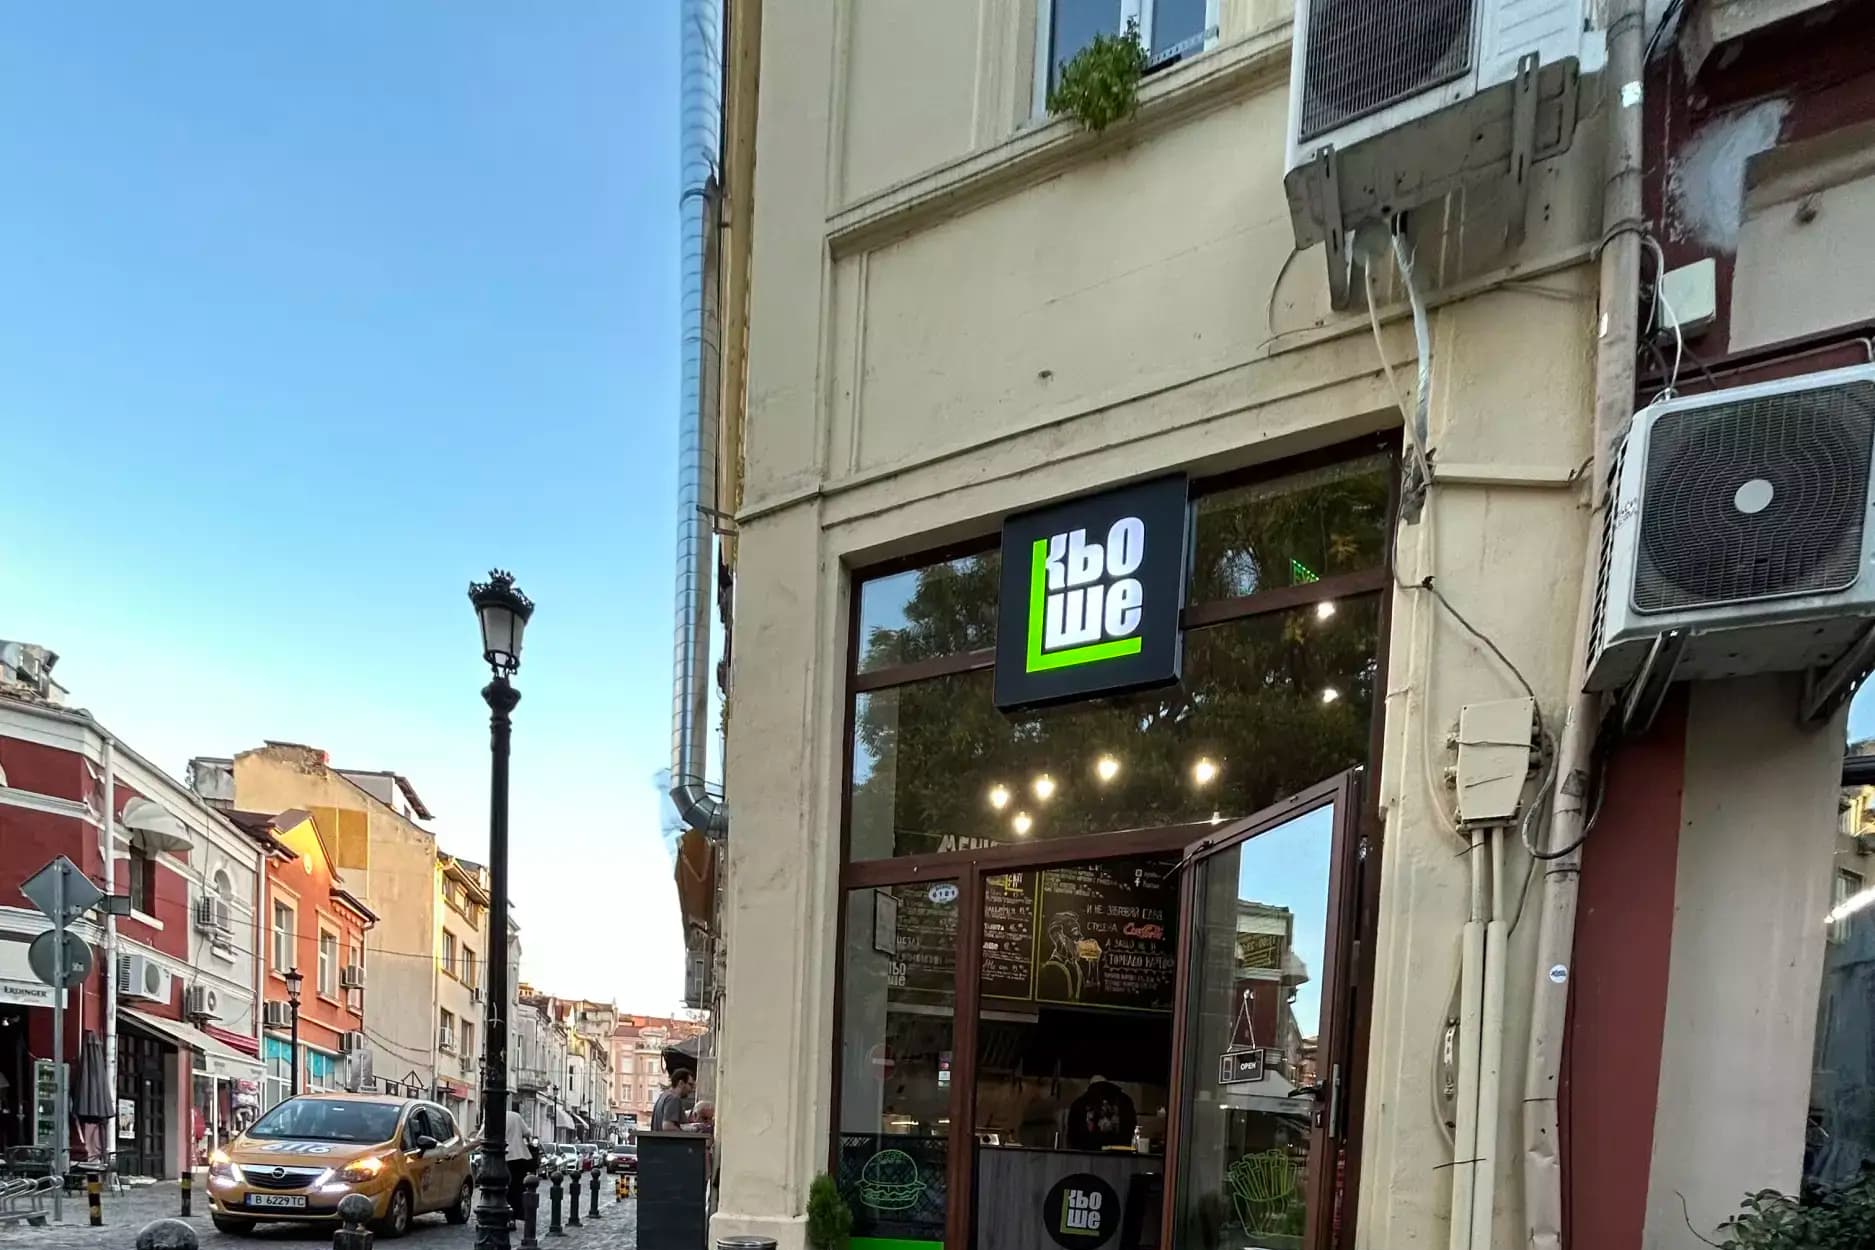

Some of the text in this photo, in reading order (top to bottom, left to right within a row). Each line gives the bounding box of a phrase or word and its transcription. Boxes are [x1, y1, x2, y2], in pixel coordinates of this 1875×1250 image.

[1044, 578, 1144, 650] ше
[4, 985, 47, 998] ERDINGER
[1240, 1061, 1257, 1071] OPEN
[266, 1196, 290, 1205] 6229
